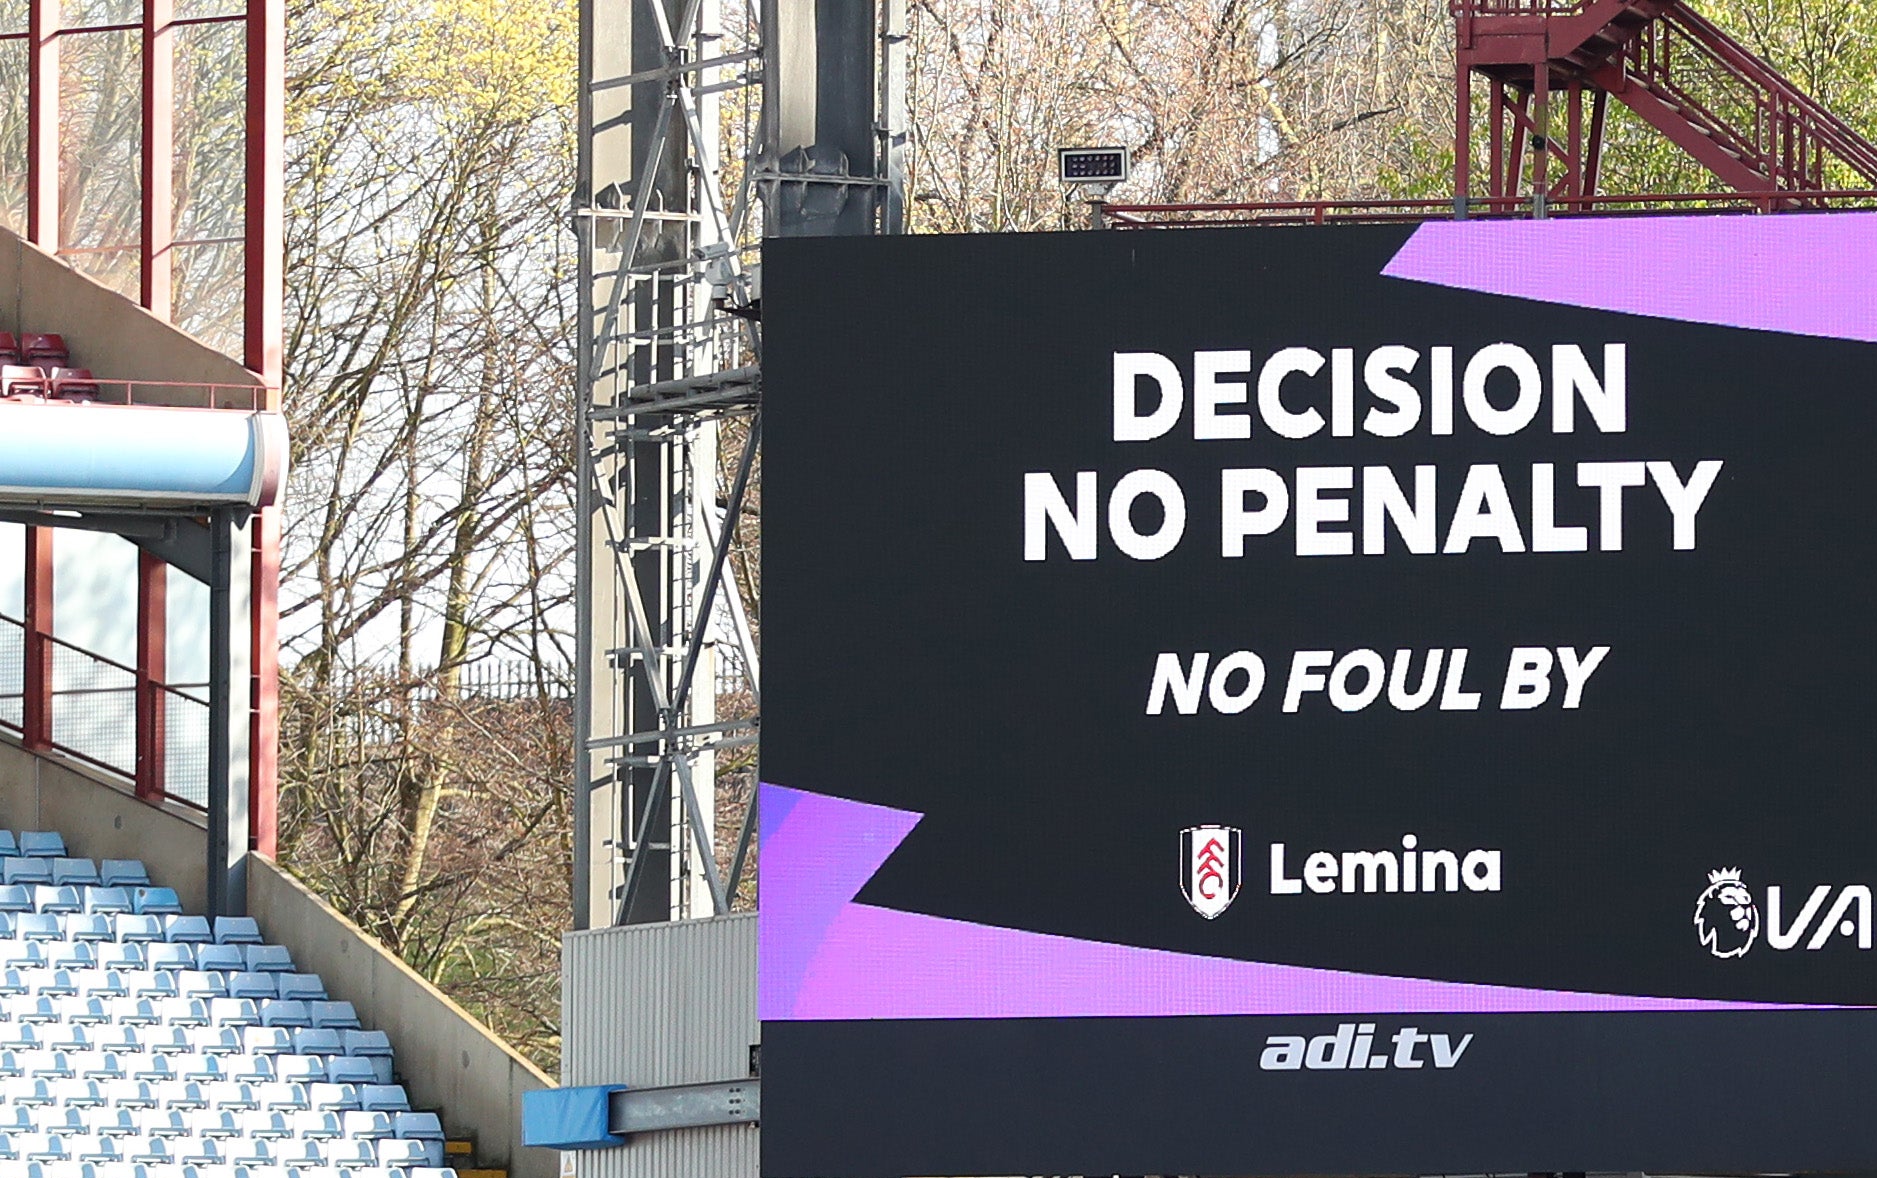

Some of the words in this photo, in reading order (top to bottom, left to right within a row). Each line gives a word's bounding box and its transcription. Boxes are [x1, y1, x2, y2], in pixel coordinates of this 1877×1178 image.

[1113, 342, 1627, 442] DECISION
[1024, 469, 1187, 561] NO
[1221, 460, 1725, 558] PENALTY
[1146, 650, 1267, 715] NO
[1282, 648, 1483, 713] FOUL
[1500, 645, 1611, 710] BY
[1270, 834, 1502, 894] Lemina
[1259, 1022, 1475, 1070] adi.tv
